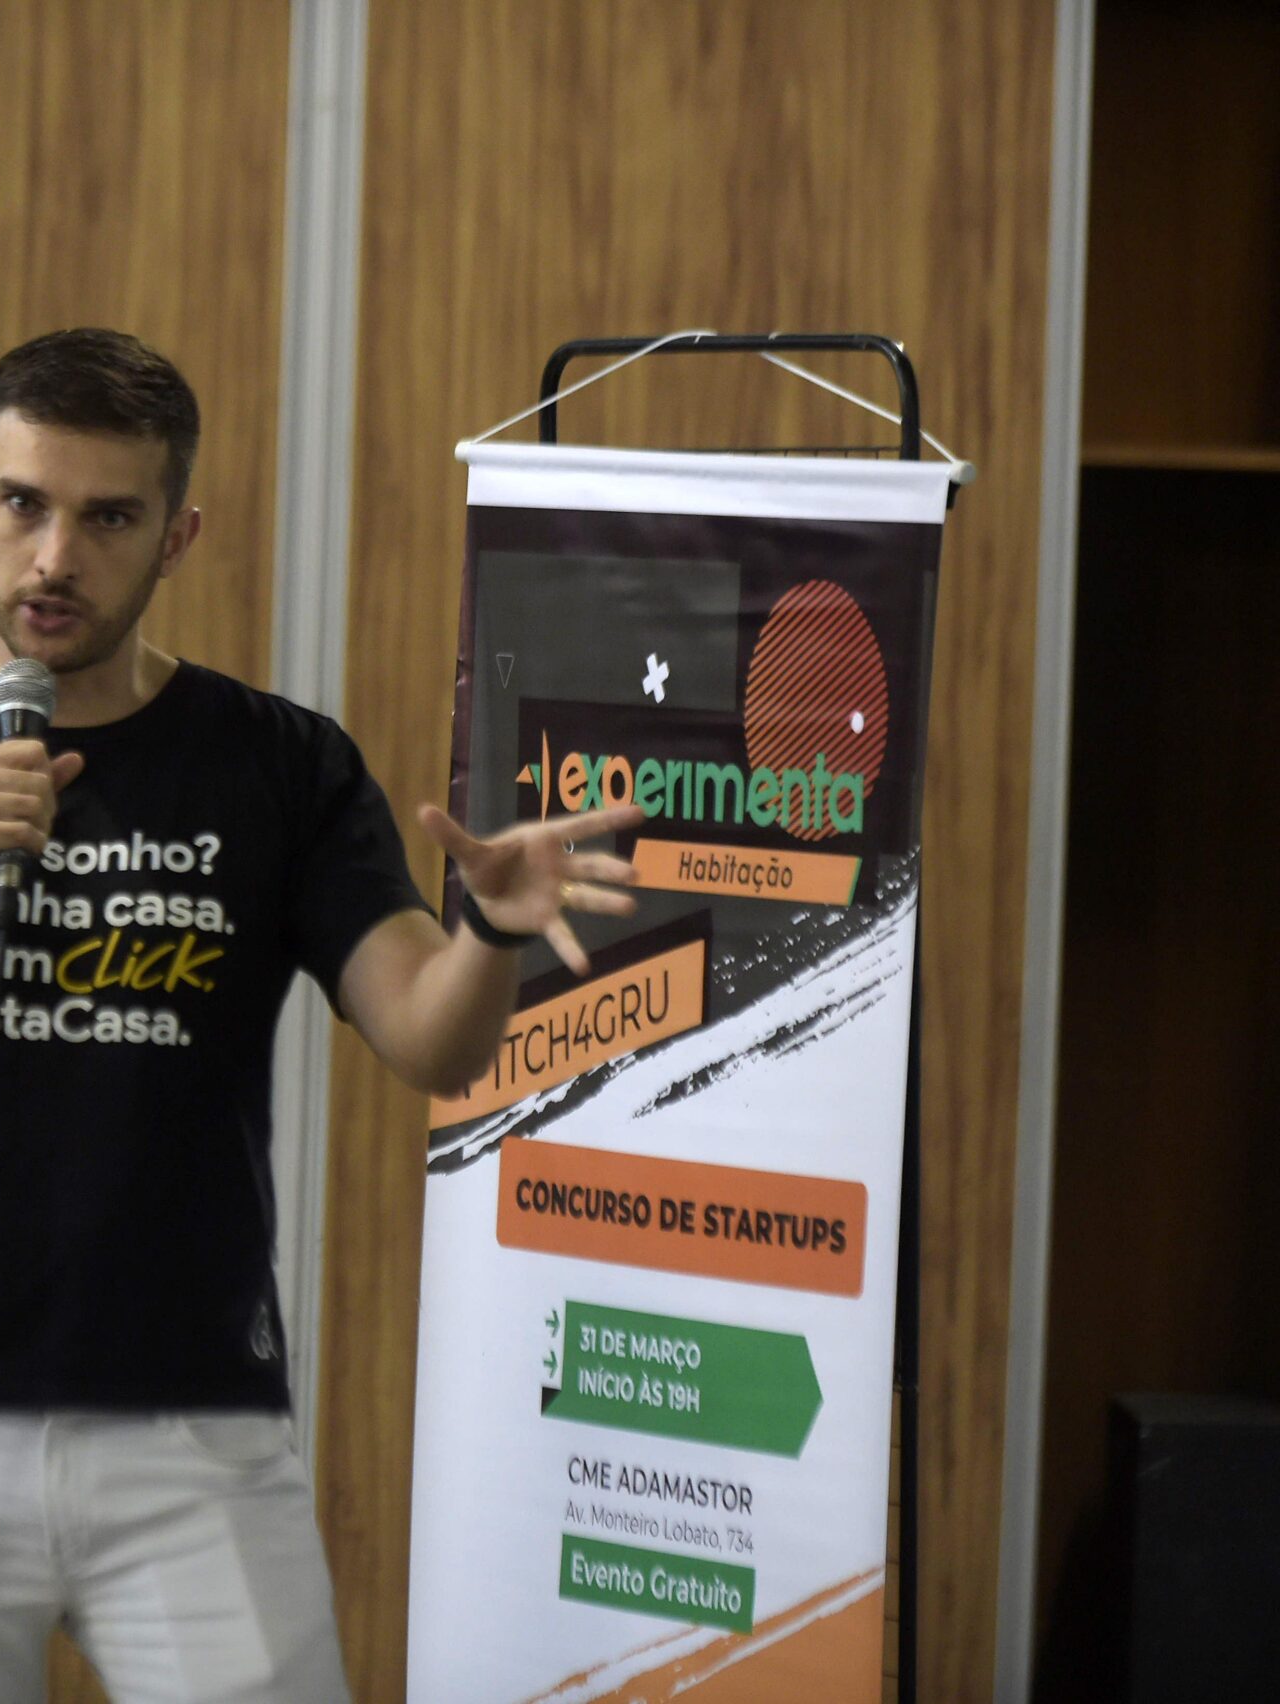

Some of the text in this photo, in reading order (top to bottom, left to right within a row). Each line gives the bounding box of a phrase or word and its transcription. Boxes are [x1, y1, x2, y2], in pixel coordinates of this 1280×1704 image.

[40, 830, 221, 876] sonho?
[678, 851, 794, 893] Habitação
[104, 891, 235, 935] casa.
[464, 970, 669, 1100] ITCH4GRU
[515, 1178, 847, 1255] CONCURSO DE STARTUPS
[579, 1324, 701, 1374] 31 DE MARÇO
[578, 1366, 701, 1414] INÍCIO ÀS 19H
[567, 1456, 753, 1516] CME ADAMASTOR
[565, 1501, 754, 1556] Av. Monteiro Lobato, 734
[571, 1551, 742, 1616] Evento Gratuito
